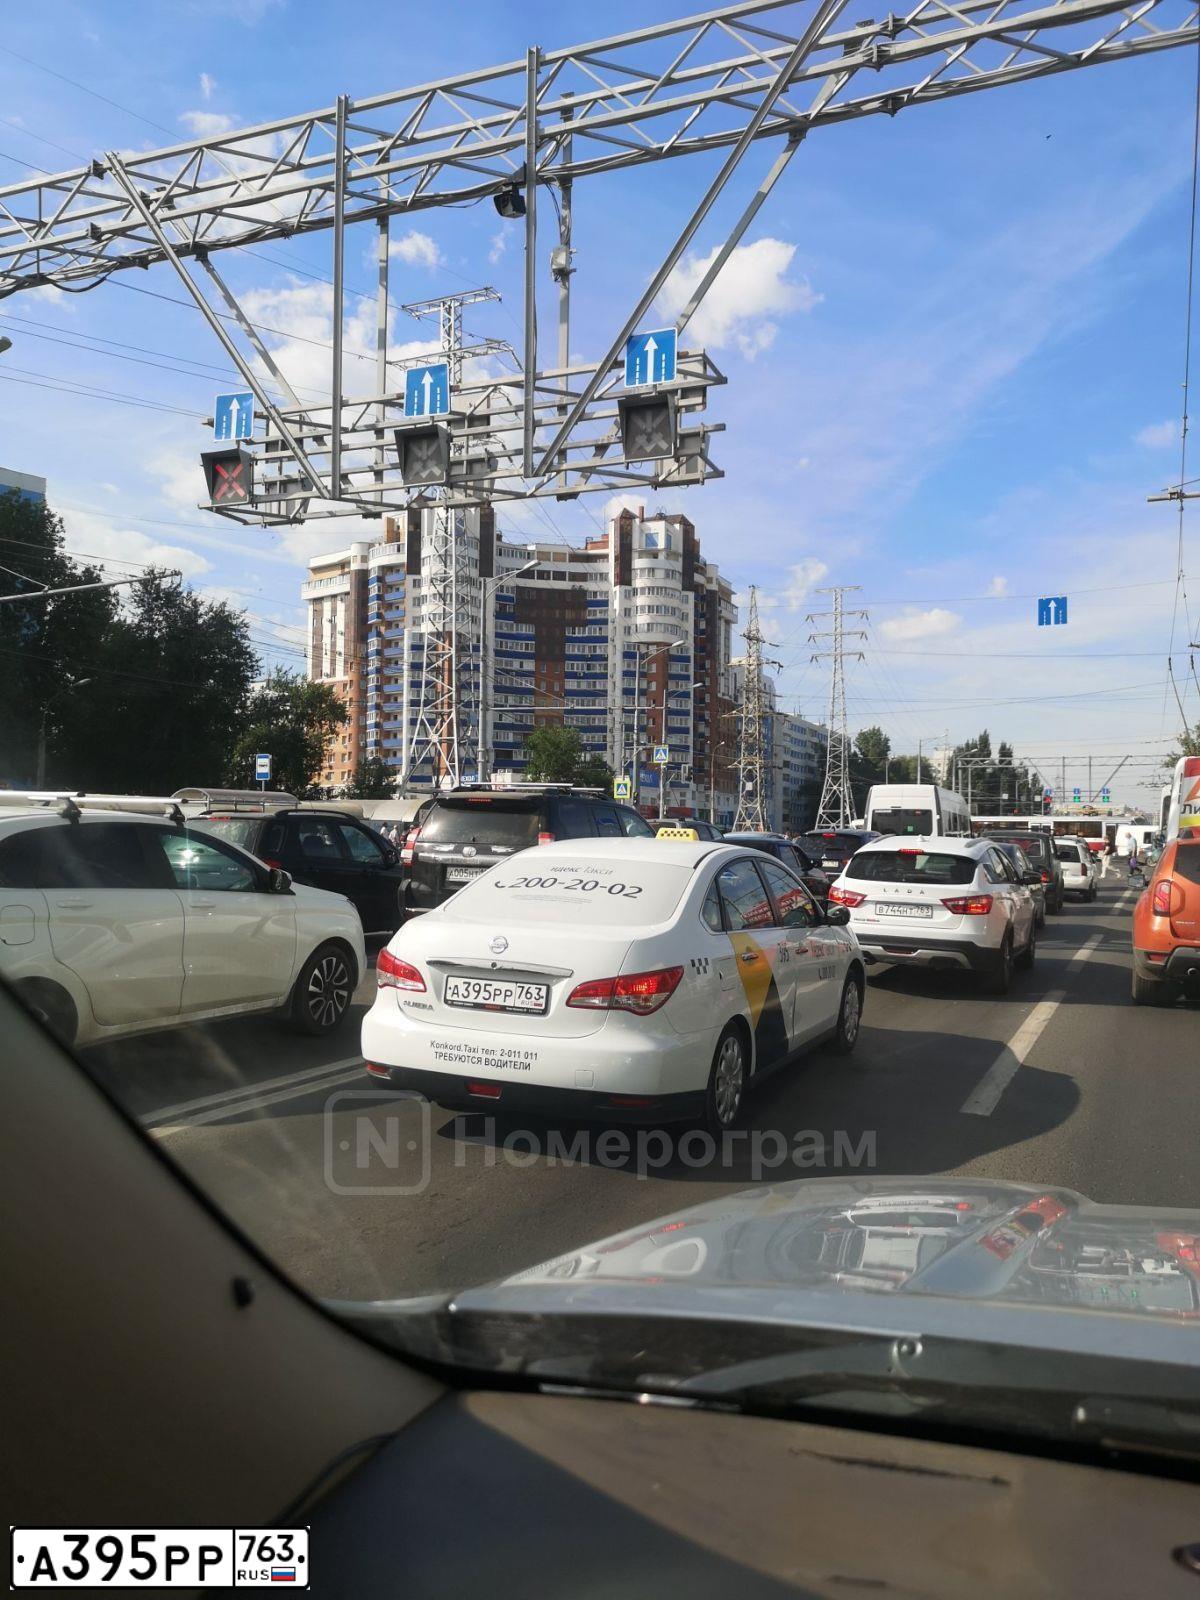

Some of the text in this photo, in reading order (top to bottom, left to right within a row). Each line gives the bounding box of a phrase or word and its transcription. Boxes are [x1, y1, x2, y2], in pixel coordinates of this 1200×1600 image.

[508, 877, 643, 899] 200-20-02
[517, 985, 542, 1001] 763
[434, 1052, 531, 1071] ТРЕБУЮТСЯ ВОДИТЕЛИ
[500, 1048, 521, 1059] 2-011
[524, 1051, 538, 1061] 011
